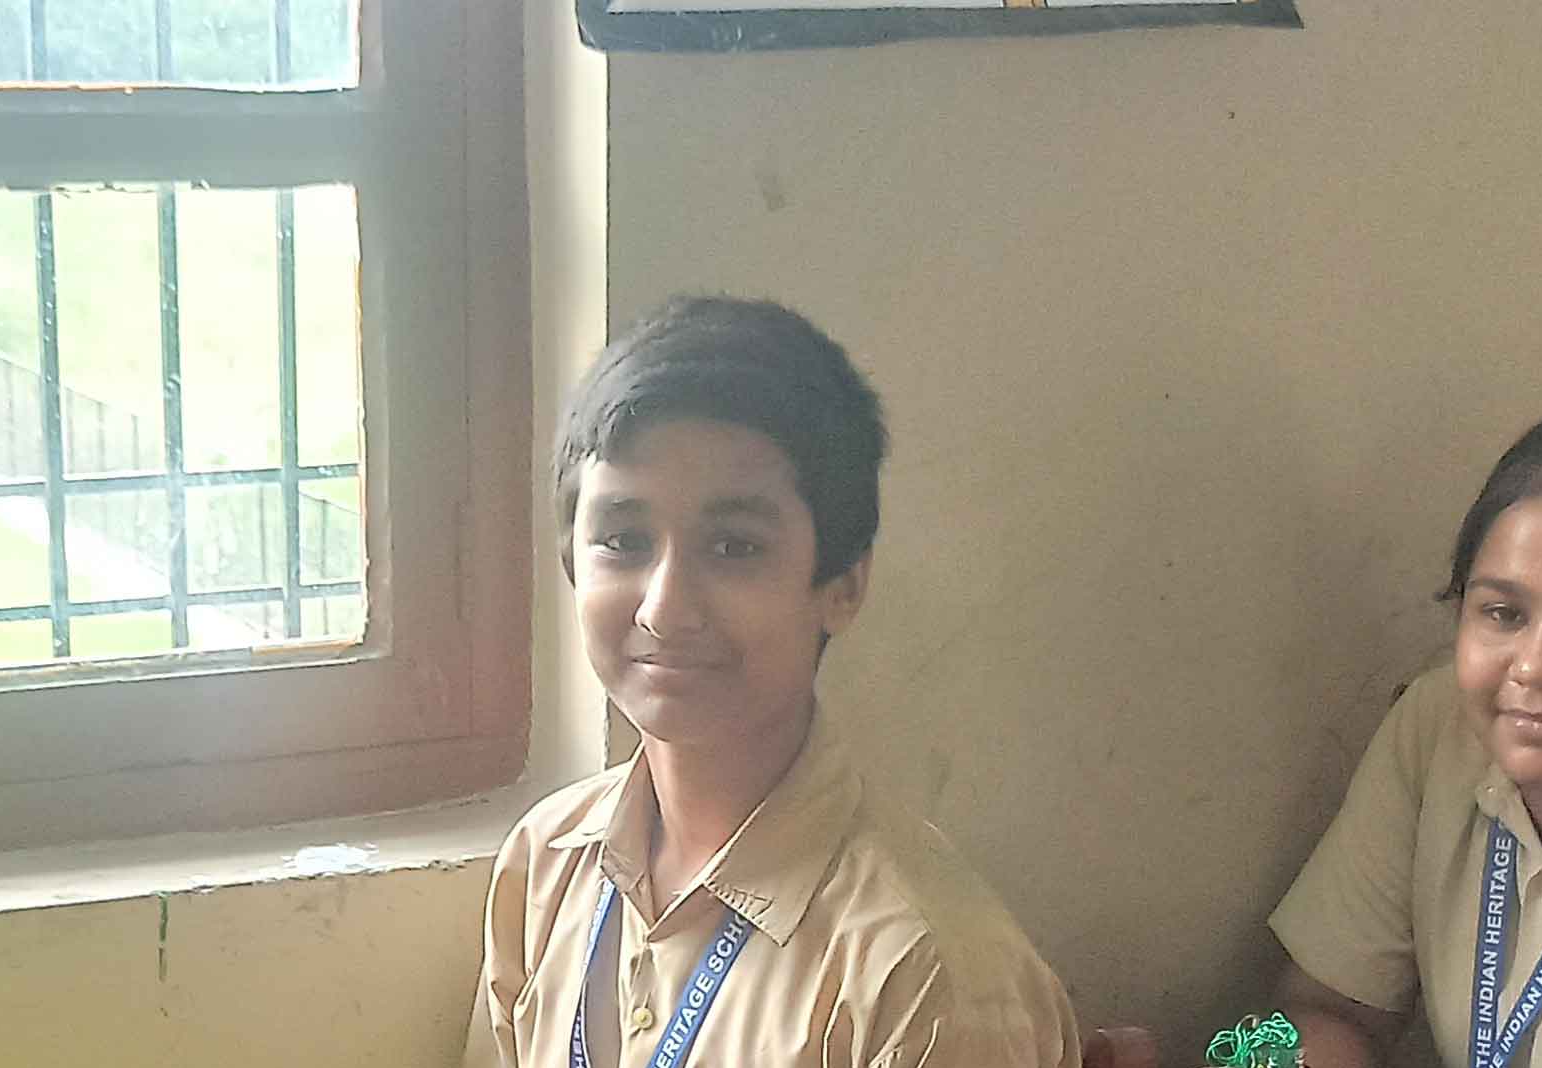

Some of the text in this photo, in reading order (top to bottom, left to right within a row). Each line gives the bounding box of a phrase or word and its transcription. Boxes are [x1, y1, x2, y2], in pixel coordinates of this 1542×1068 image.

[1475, 836, 1512, 1068] THE INDIAN HERITAGE
[1498, 986, 1542, 1058] INDIAN
